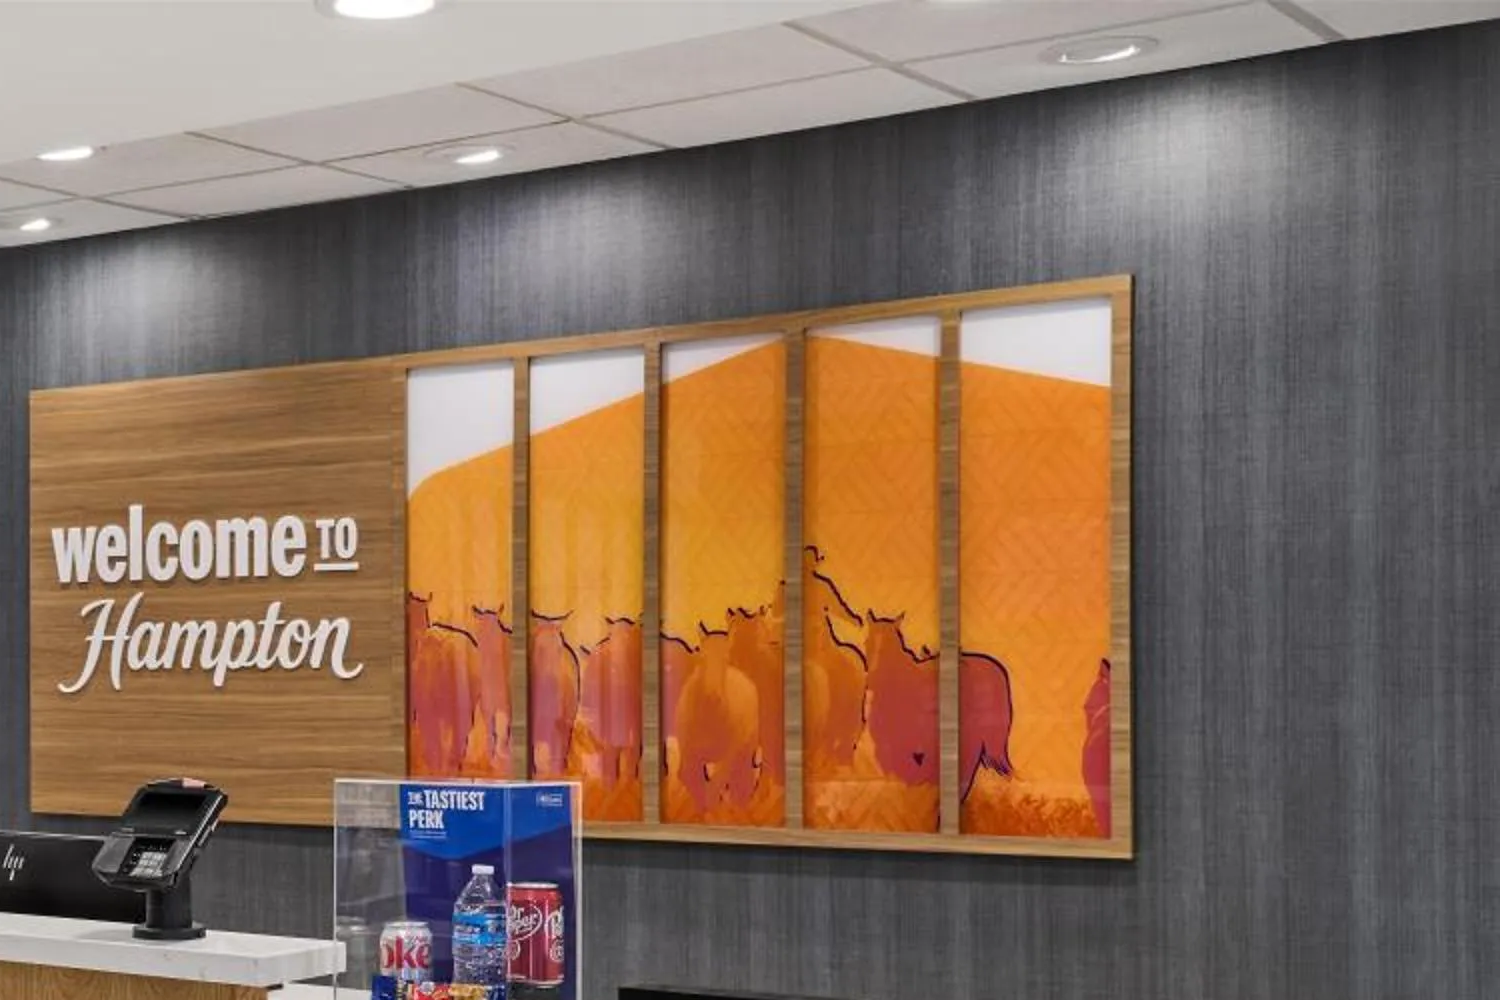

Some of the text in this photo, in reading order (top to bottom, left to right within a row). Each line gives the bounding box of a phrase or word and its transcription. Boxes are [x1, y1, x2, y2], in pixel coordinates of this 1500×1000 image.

[51, 503, 359, 584] welcome TO
[57, 591, 364, 693] Hampton
[408, 809, 445, 830] PERK
[423, 789, 485, 811] TASTIEST
